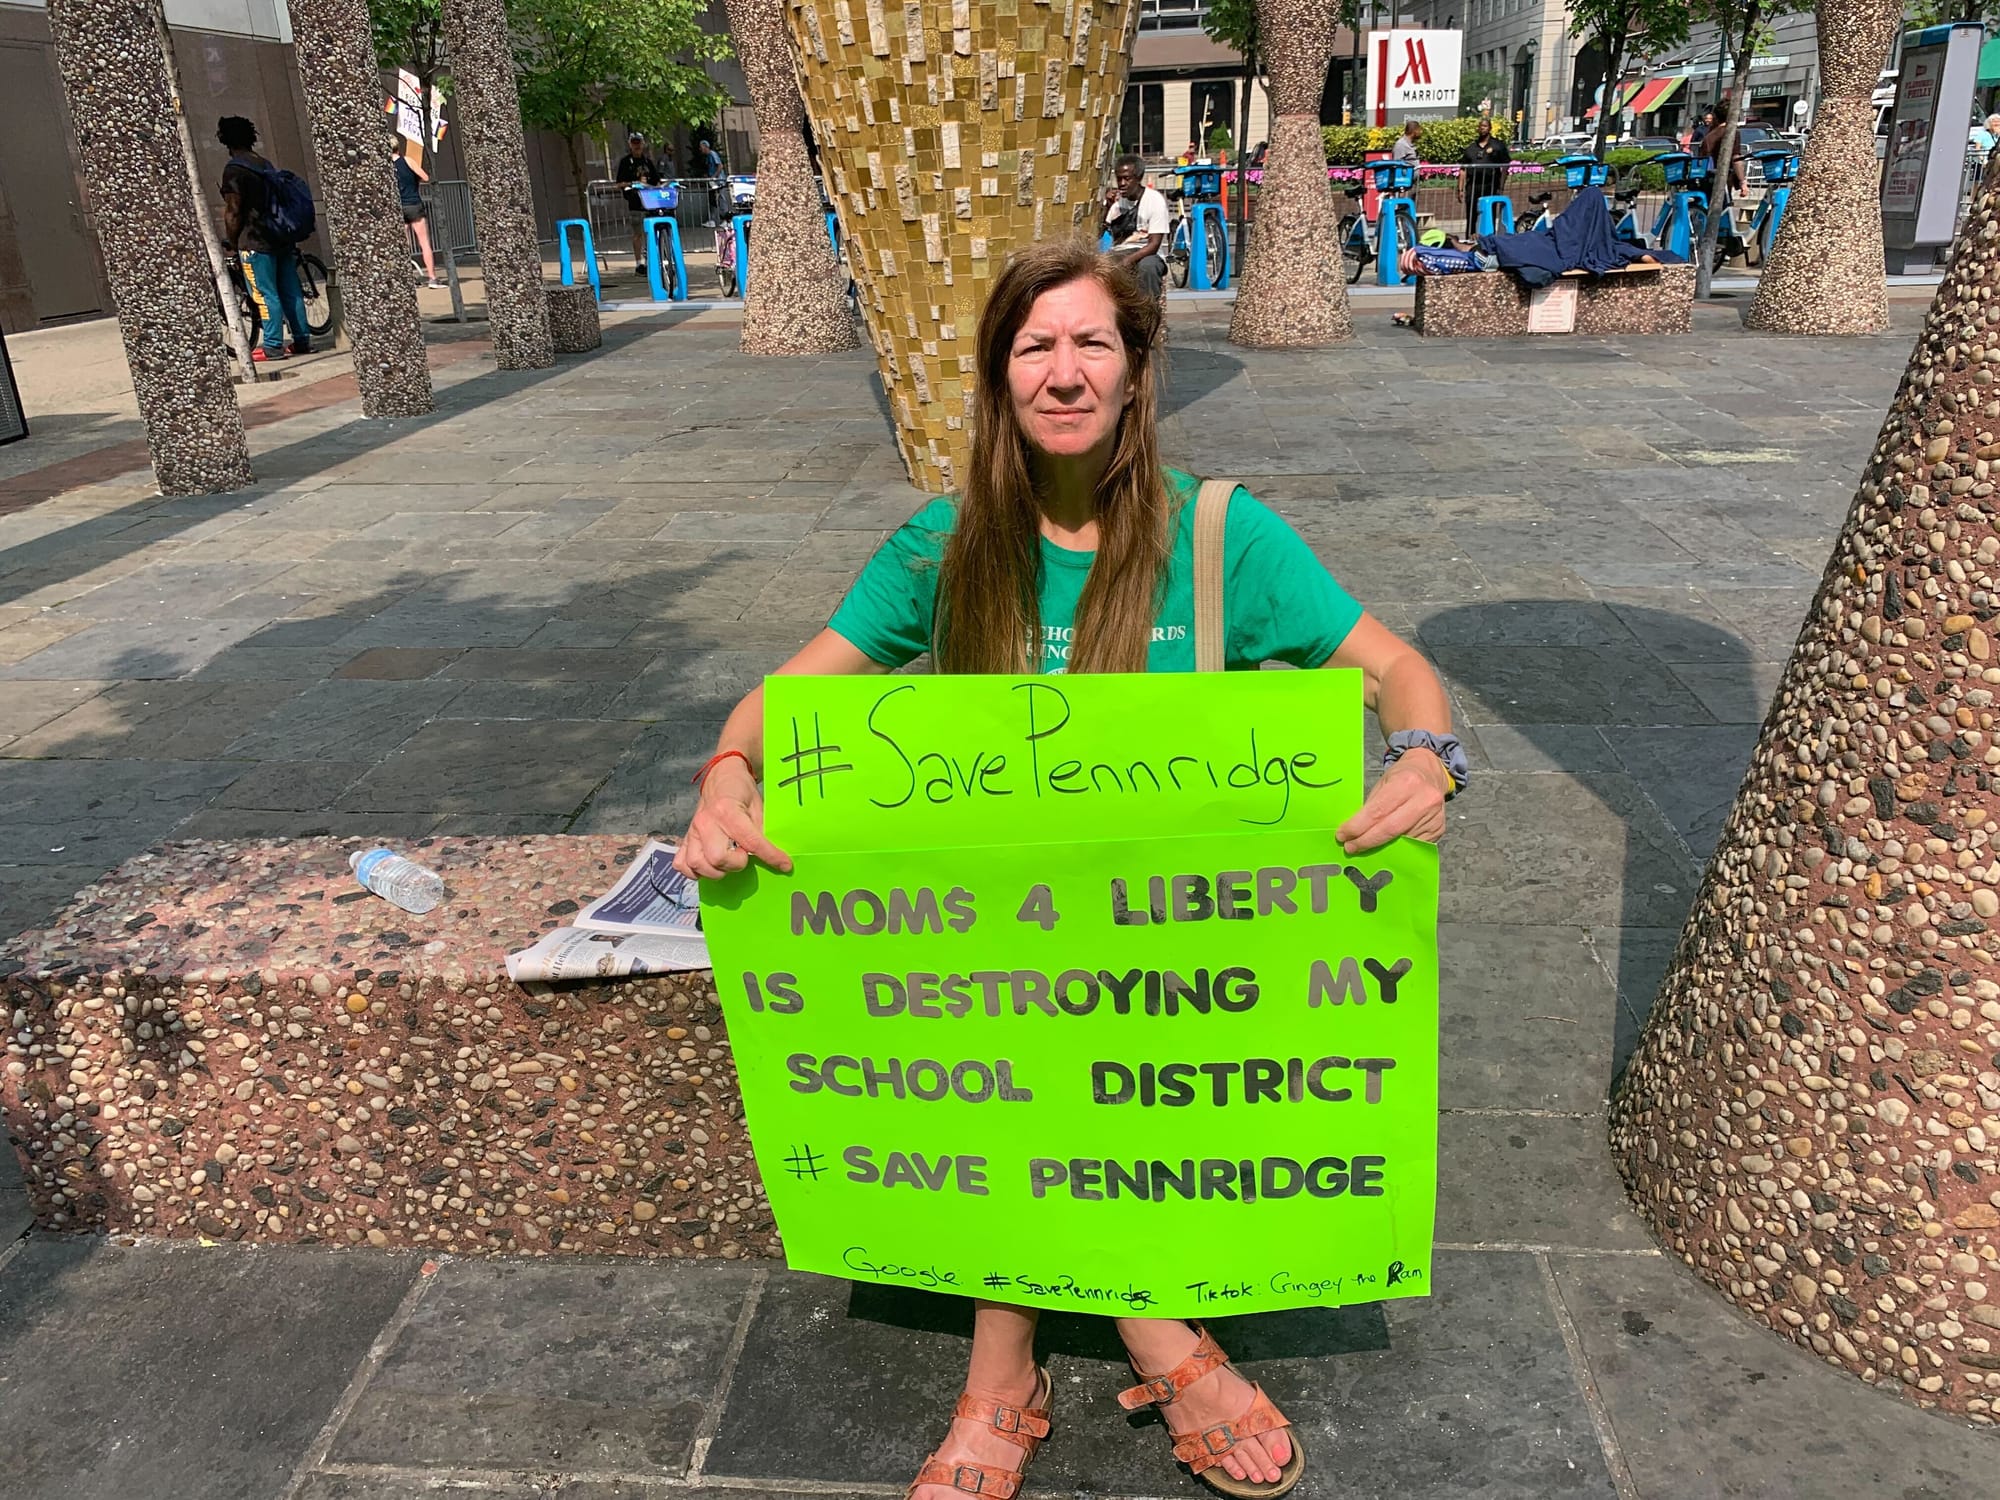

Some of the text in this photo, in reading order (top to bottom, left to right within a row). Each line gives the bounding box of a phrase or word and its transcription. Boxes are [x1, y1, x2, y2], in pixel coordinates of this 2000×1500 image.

[1403, 89, 1456, 101] MARRIOTT
[791, 864, 1393, 936] MOM$ 4 LIBERTY
[743, 957, 1412, 1018] IS DE$TROYING MY
[787, 1054, 1396, 1107] SCHOOL DISTRICT
[1030, 1155, 1386, 1204] PENNRIDGE
[1386, 1260, 1422, 1287] Ram
